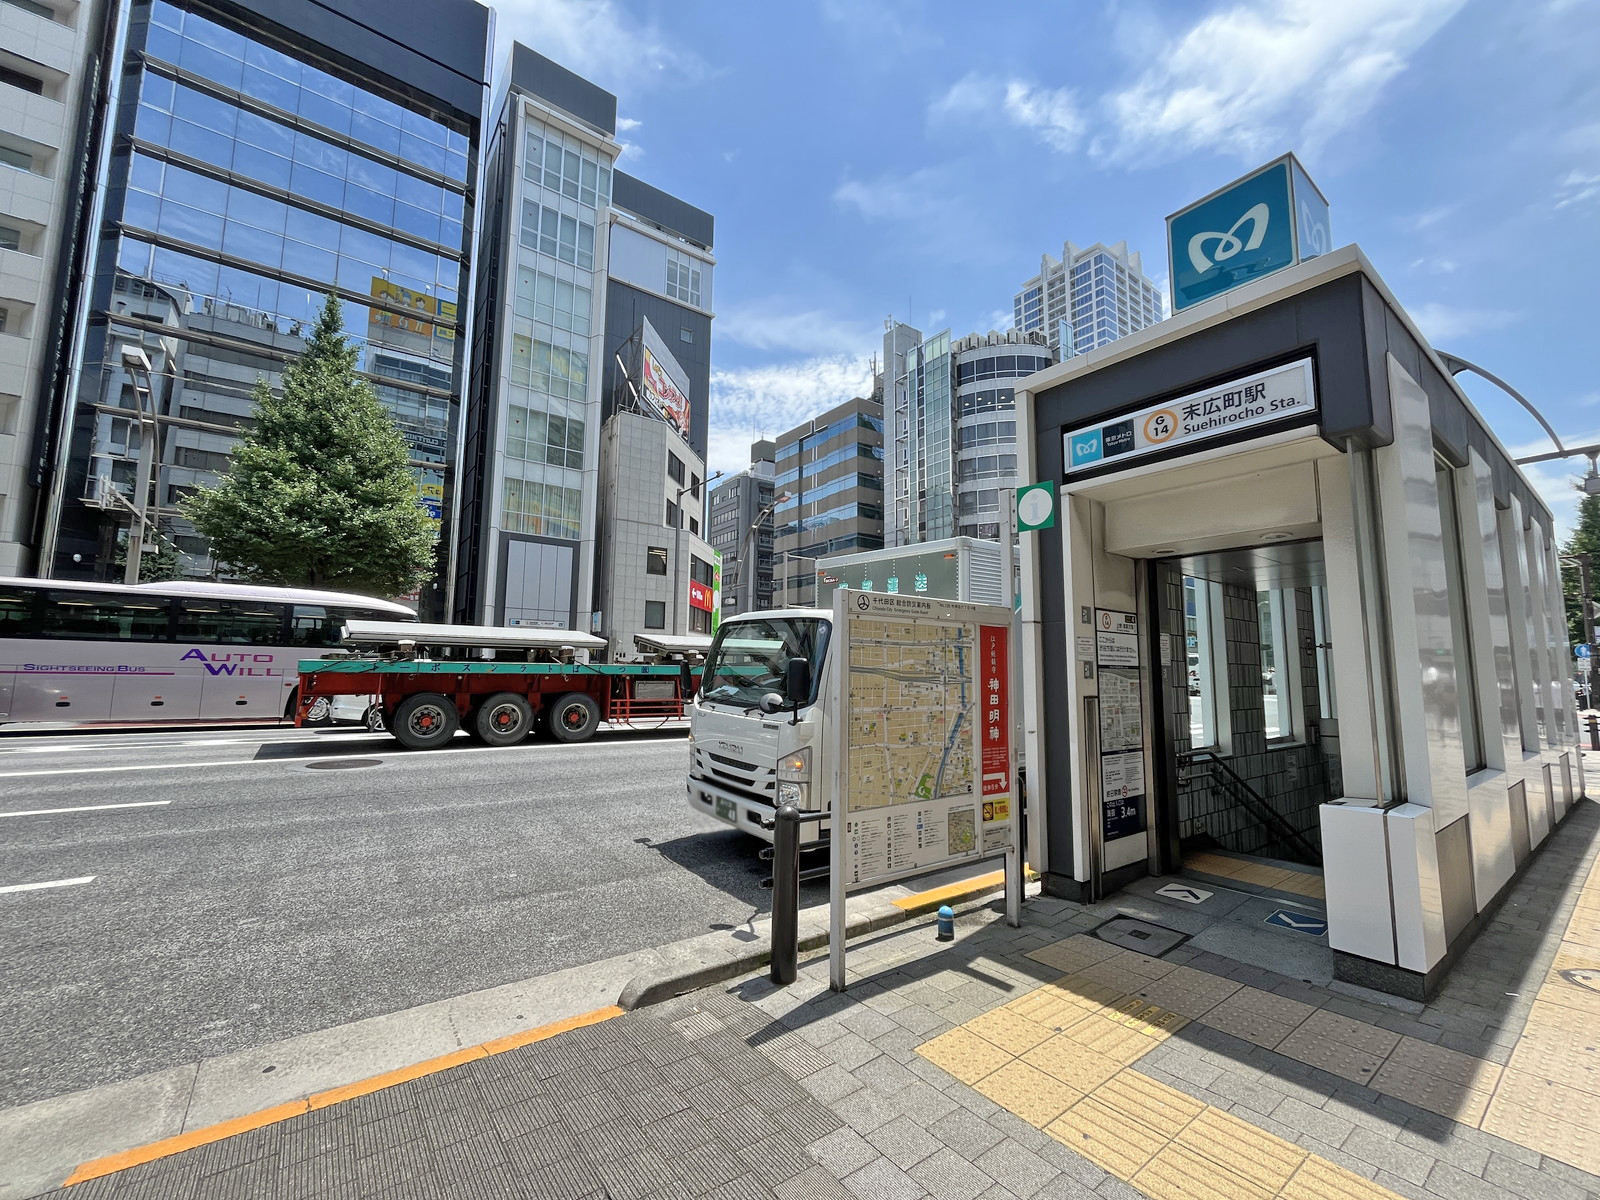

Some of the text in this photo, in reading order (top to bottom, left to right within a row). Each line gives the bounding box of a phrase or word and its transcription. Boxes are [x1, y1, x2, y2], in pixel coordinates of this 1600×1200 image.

[1182, 382, 1266, 421] 末広町駅
[1155, 415, 1165, 425] G
[1184, 397, 1301, 434] Suehirocho Sta.
[1153, 424, 1169, 437] 14
[872, 597, 895, 606] 千代田区
[180, 648, 274, 662] AUTO
[23, 663, 115, 672] SIGHTSEEING
[203, 663, 283, 677] WILL
[988, 678, 1000, 741] 神田明神
[1121, 807, 1136, 818] 3.4m
